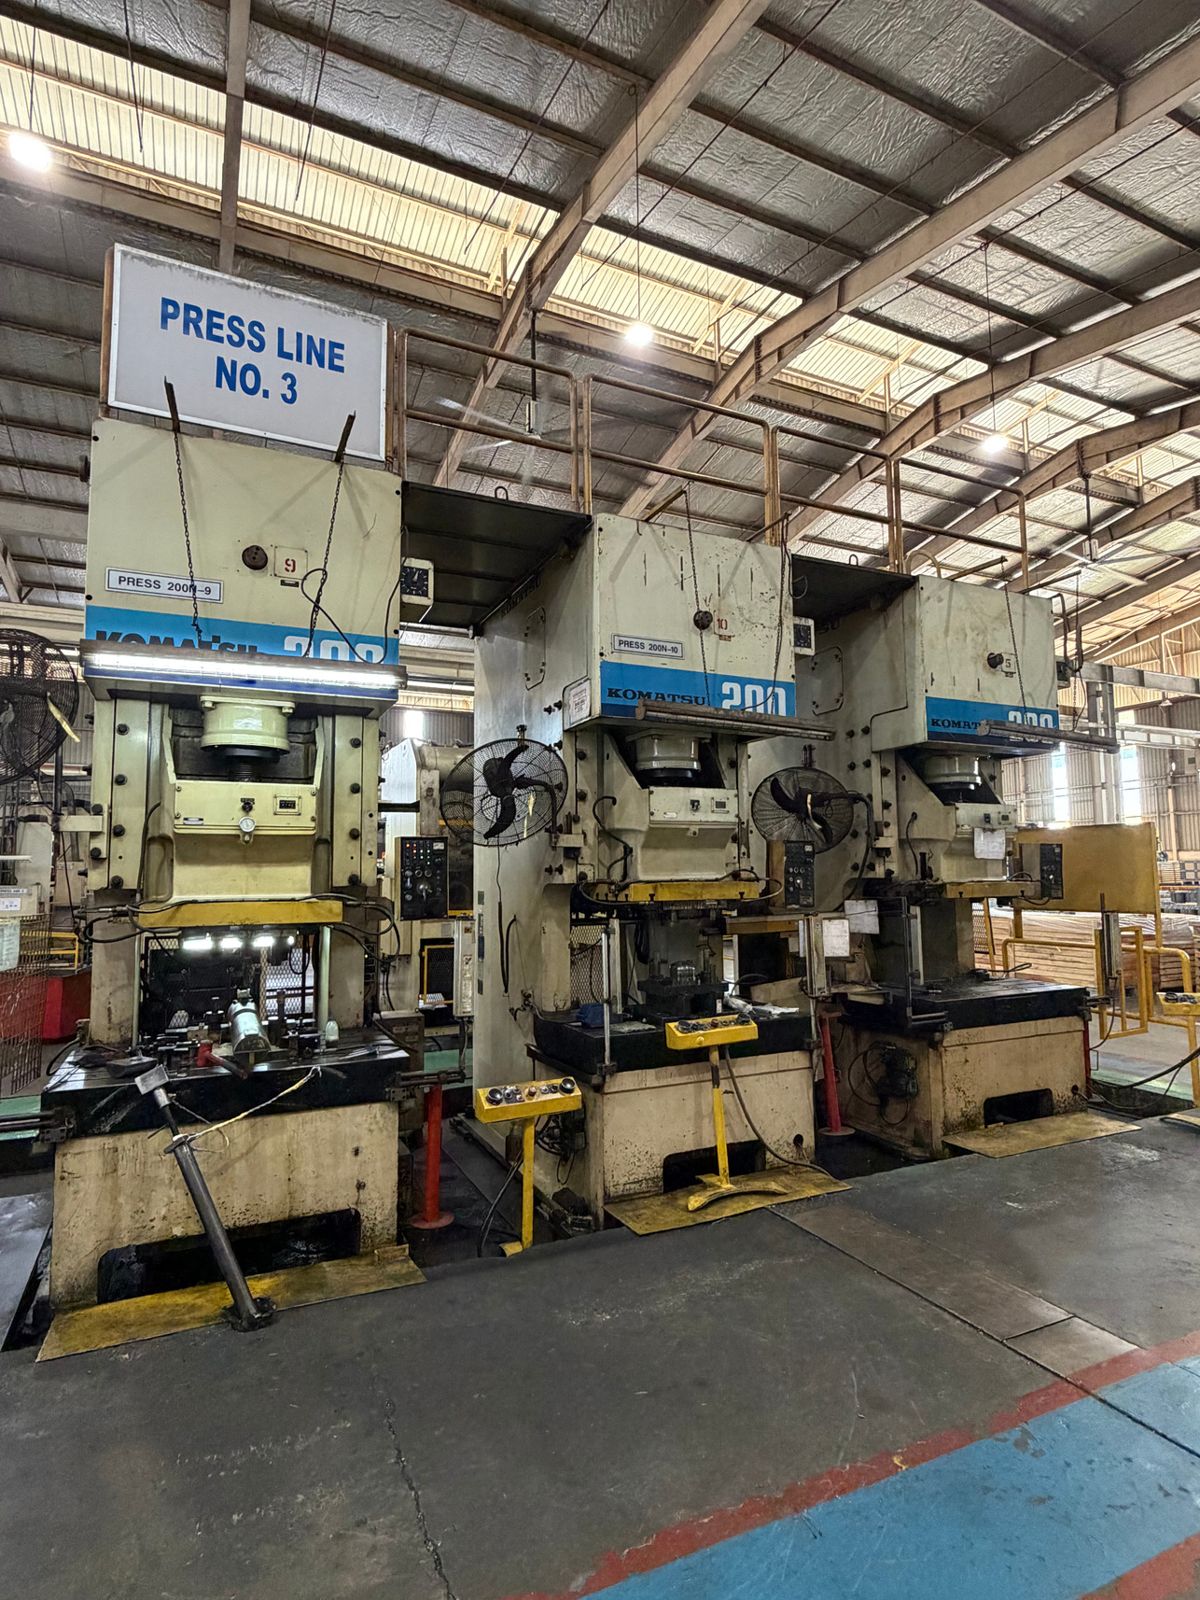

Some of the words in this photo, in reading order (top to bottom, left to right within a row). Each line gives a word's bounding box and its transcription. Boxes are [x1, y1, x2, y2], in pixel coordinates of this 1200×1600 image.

[160, 297, 266, 353] PRESS
[277, 327, 345, 373] LINE
[215, 356, 270, 399] NO.
[280, 372, 298, 405] 3
[284, 558, 296, 573] 9
[118, 575, 161, 589] PRESS
[167, 582, 212, 595] 200N-9
[618, 639, 645, 650] PRESS
[648, 643, 678, 654] 200N-10
[1005, 658, 1011, 668] 5
[607, 688, 705, 705] KOMATSU
[931, 718, 981, 730] KOMAT
